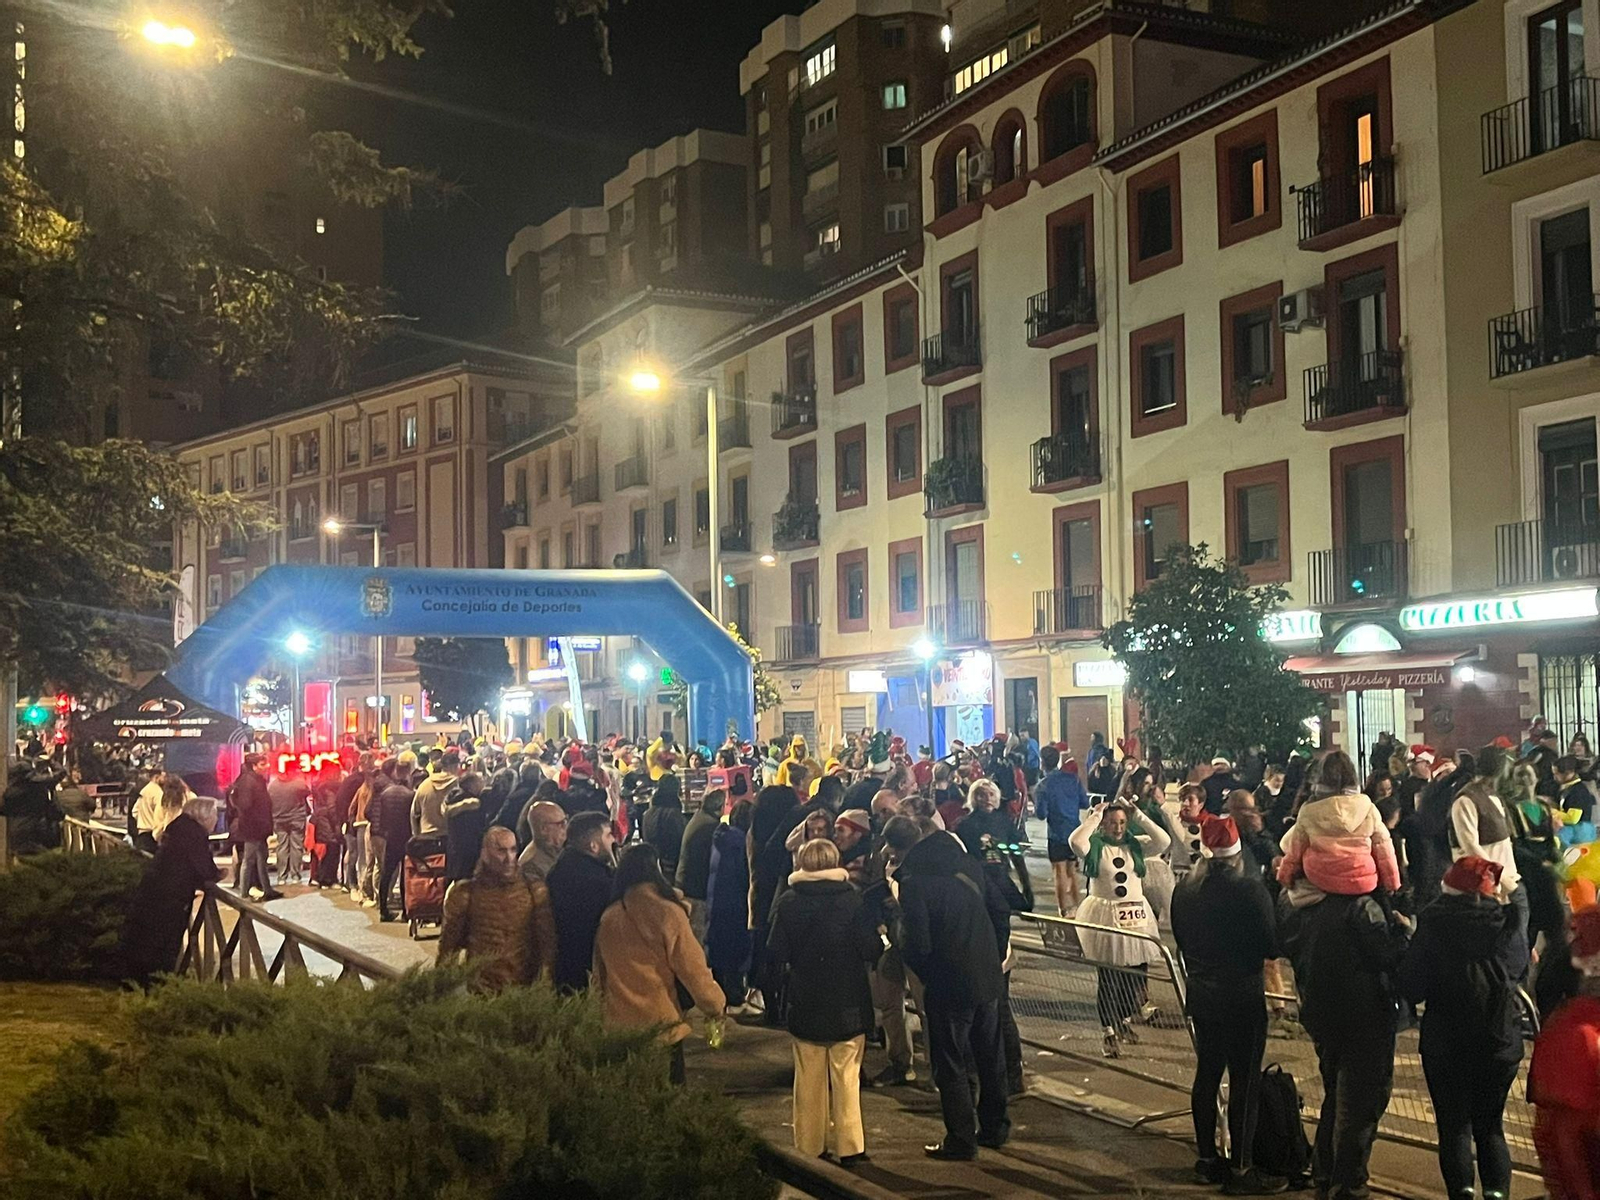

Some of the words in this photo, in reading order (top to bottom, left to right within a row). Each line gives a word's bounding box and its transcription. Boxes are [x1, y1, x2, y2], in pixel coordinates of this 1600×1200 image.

[514, 586, 531, 597] DE
[534, 585, 597, 598] GRANADA
[501, 600, 519, 612] de
[523, 601, 582, 614] Deportes
[1398, 669, 1445, 685] PIZZERÍA
